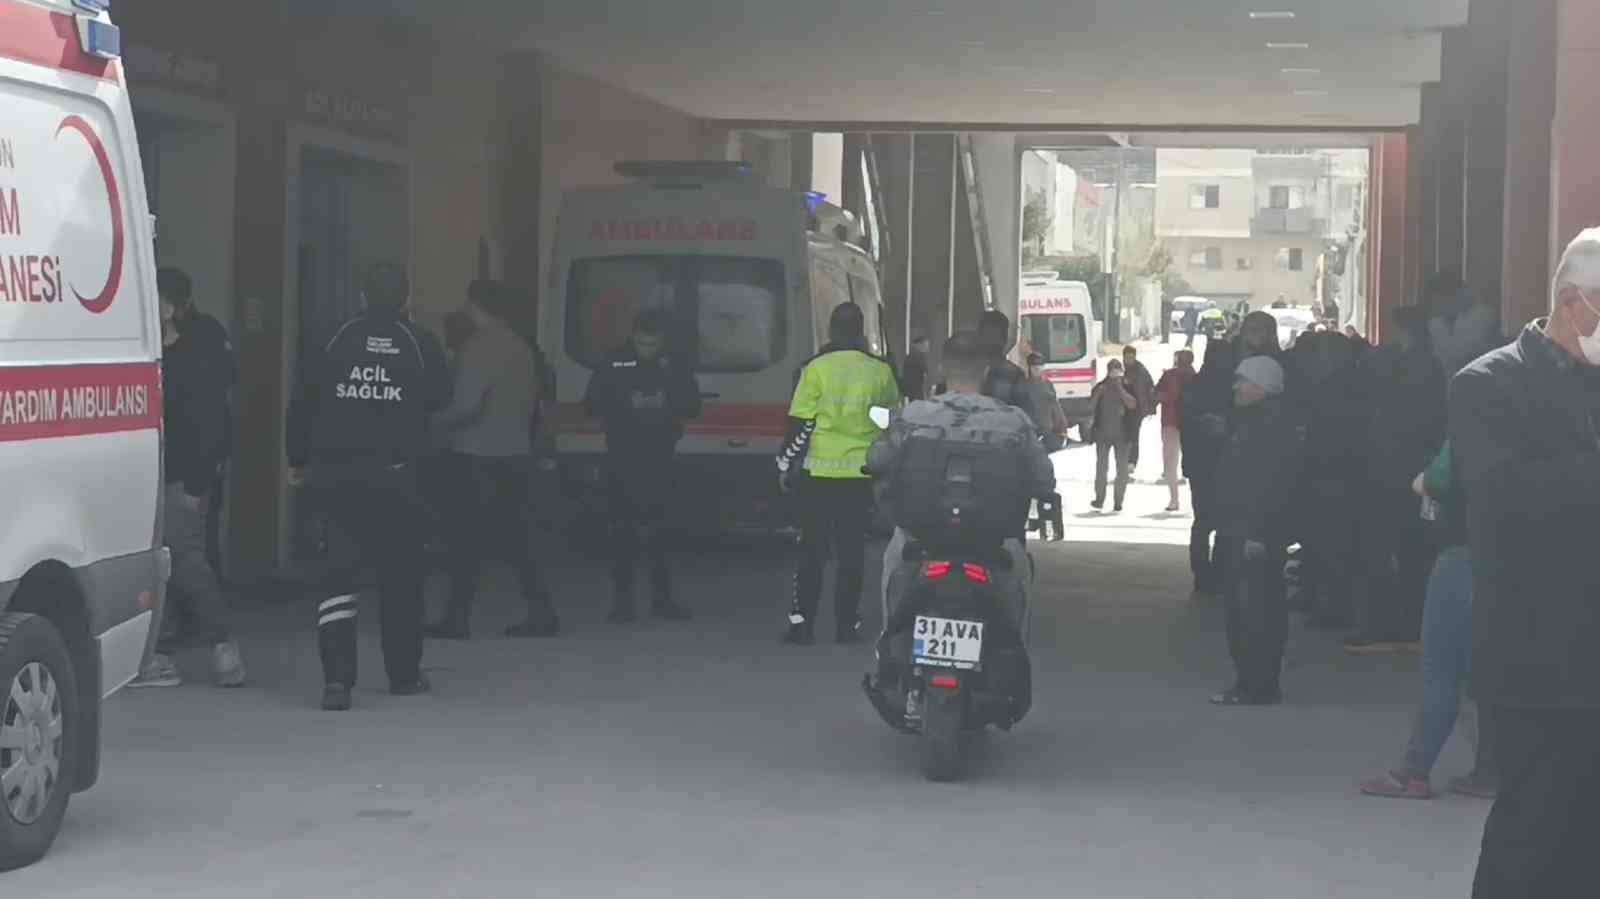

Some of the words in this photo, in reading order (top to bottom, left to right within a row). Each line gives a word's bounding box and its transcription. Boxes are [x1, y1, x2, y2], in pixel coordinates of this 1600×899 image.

[336, 382, 402, 401] SAĞLIK
[0, 388, 57, 425] ARDIM
[61, 384, 148, 419] AMBULANSI
[917, 618, 937, 635] 31
[943, 622, 980, 640] AVA
[928, 638, 956, 656] 211
